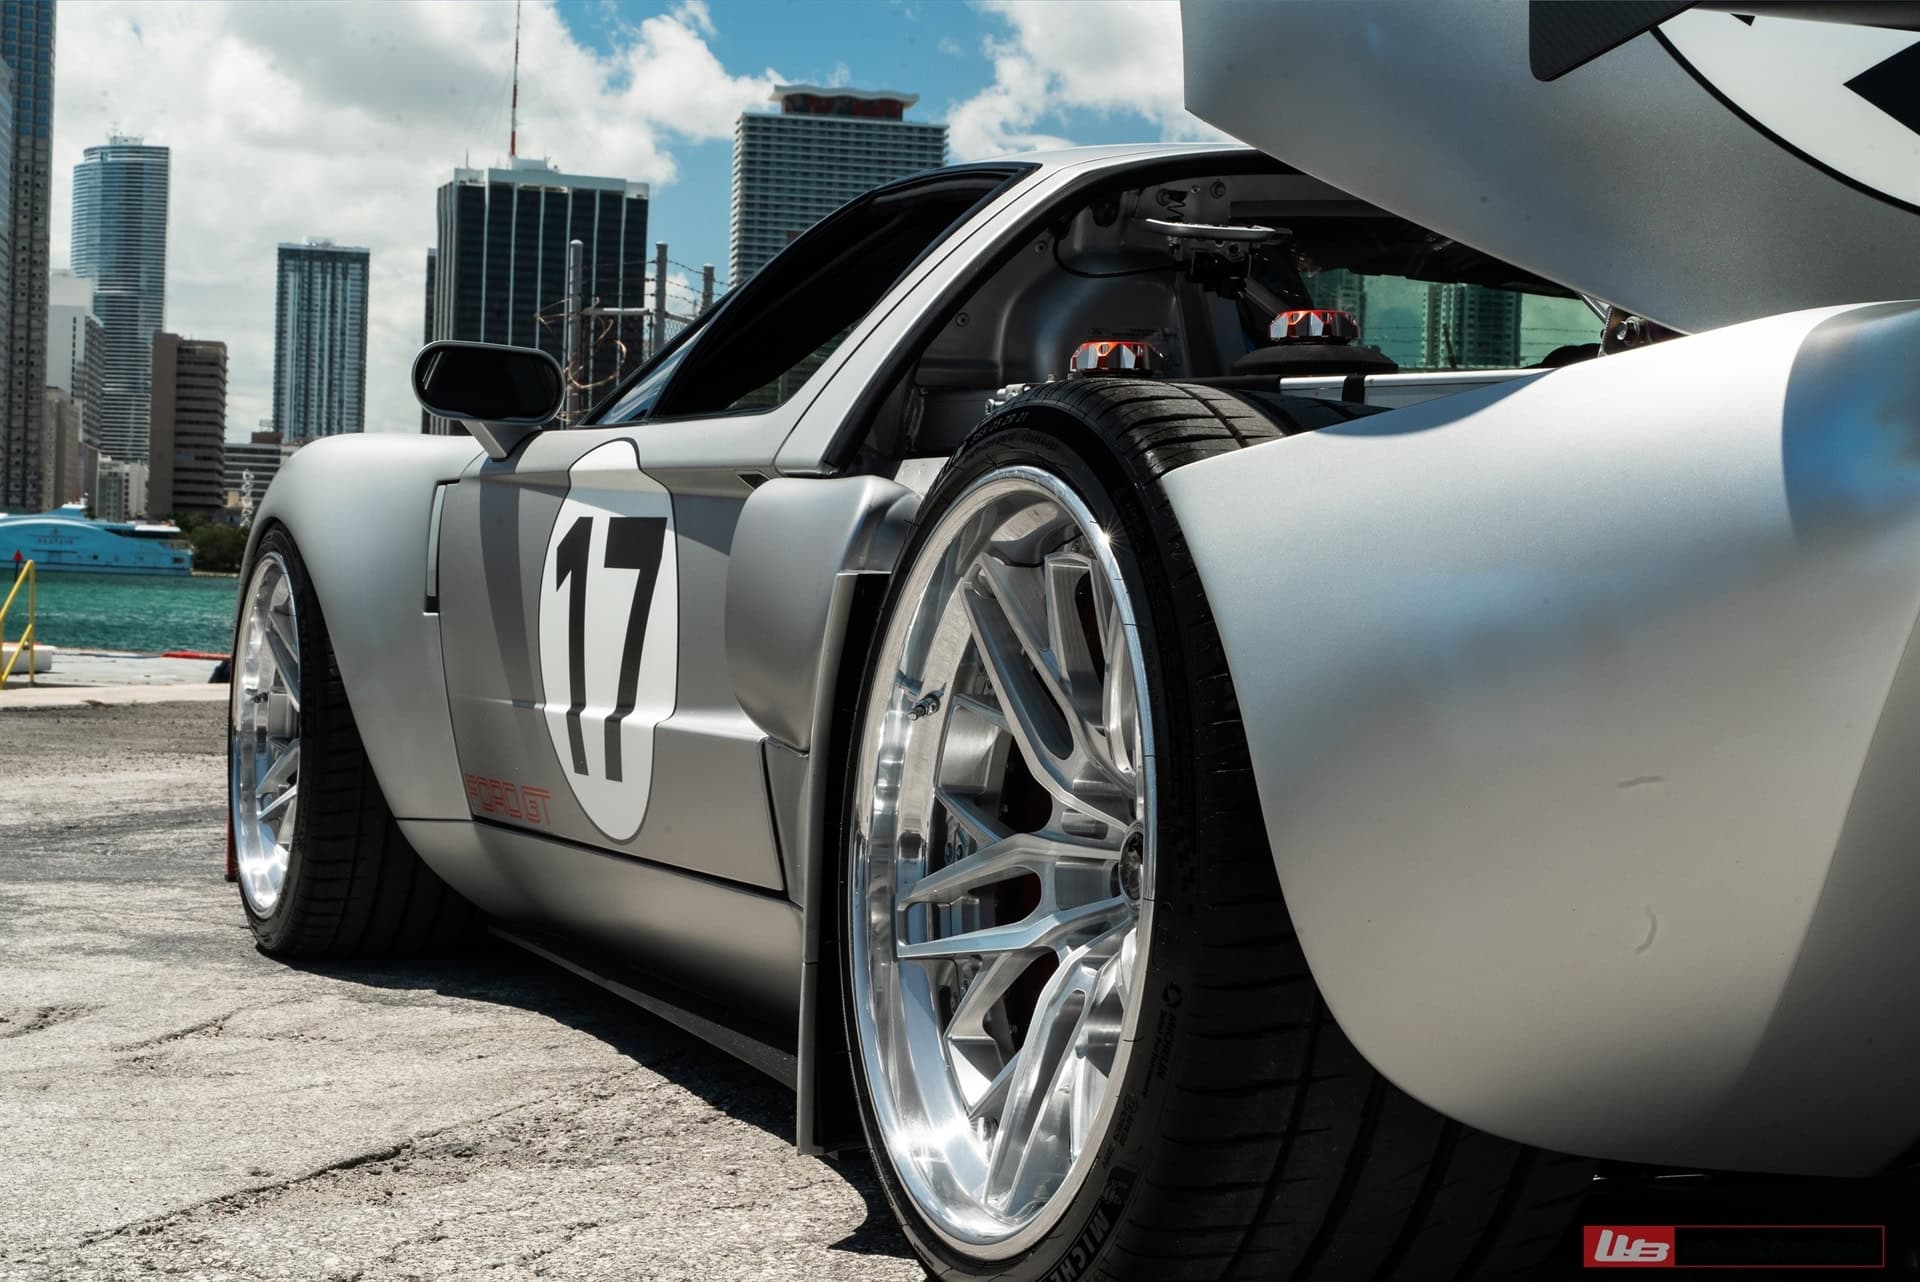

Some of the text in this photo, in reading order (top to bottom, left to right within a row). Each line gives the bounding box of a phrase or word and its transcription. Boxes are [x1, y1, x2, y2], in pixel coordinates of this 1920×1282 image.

[555, 516, 668, 782] 17
[464, 773, 551, 827] FORD GT
[1156, 1012, 1177, 1081] MICHELIN
